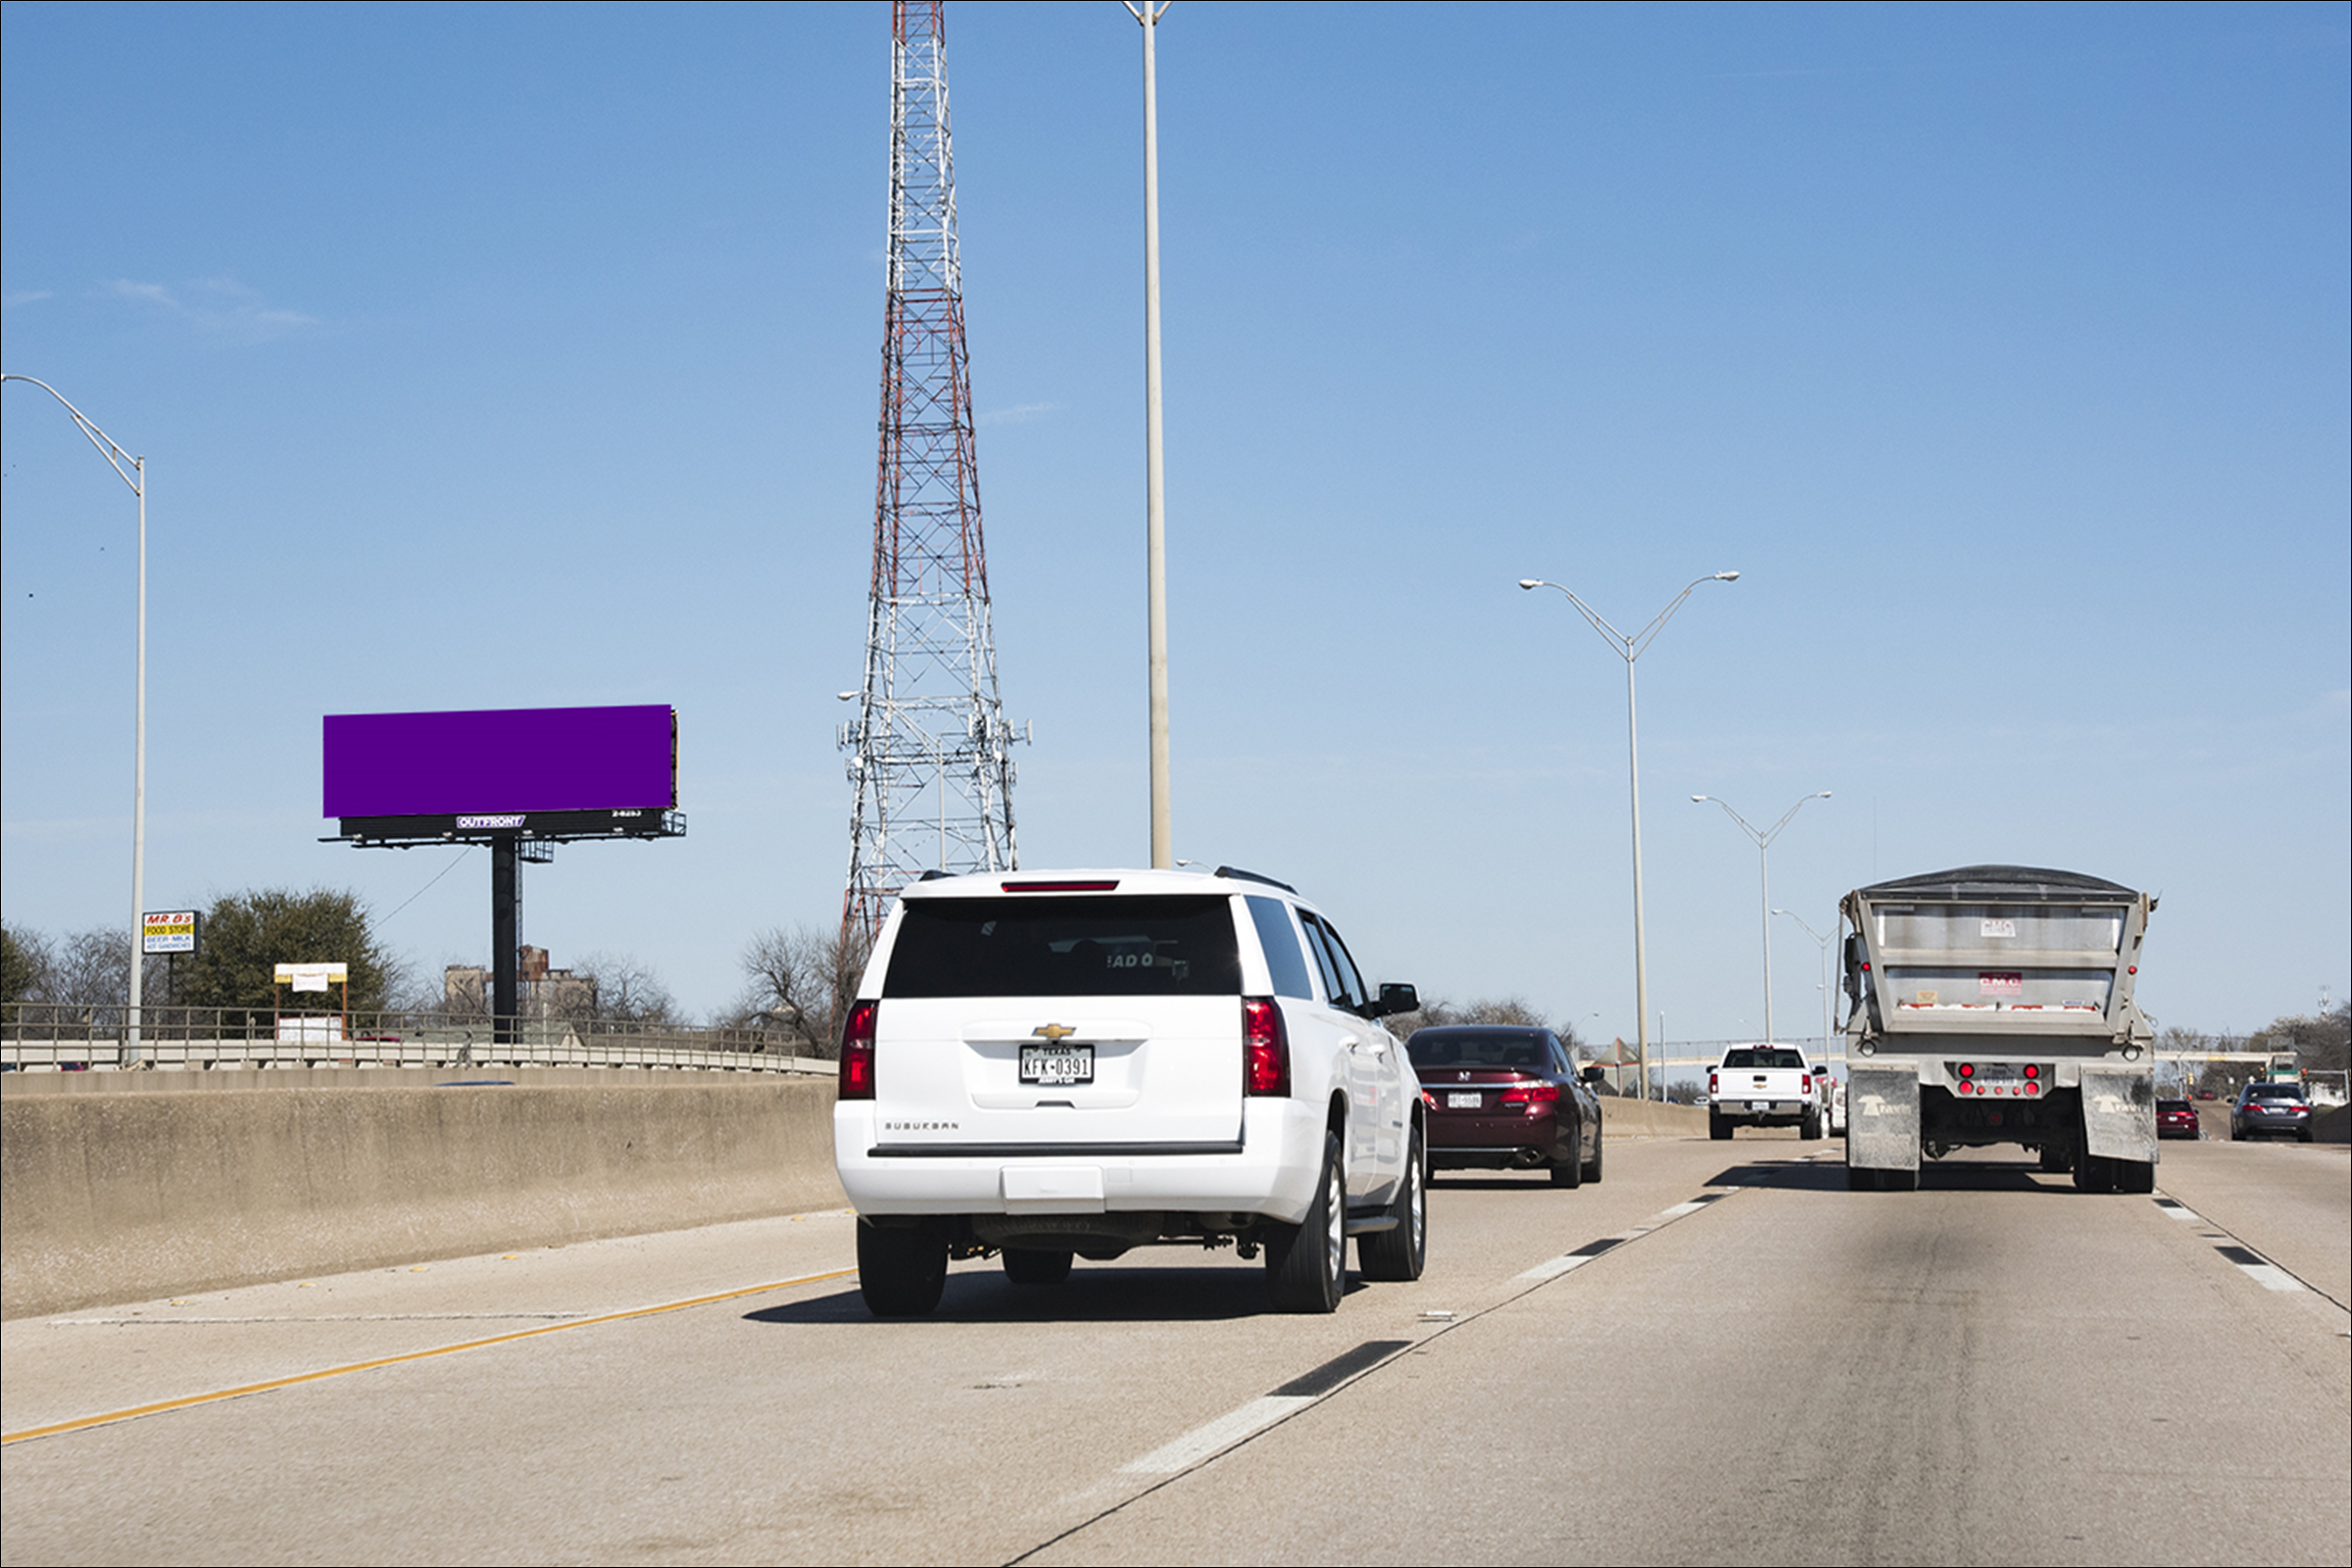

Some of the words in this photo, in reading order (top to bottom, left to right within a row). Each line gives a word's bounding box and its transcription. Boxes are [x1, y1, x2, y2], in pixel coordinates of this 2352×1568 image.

[459, 816, 524, 828] OUTFRONT
[146, 913, 171, 925] MR.
[146, 925, 167, 936] FOOD
[169, 924, 191, 935] STORE
[1043, 1048, 1071, 1056] TEXAS
[885, 1122, 959, 1131] SUBURBAN
